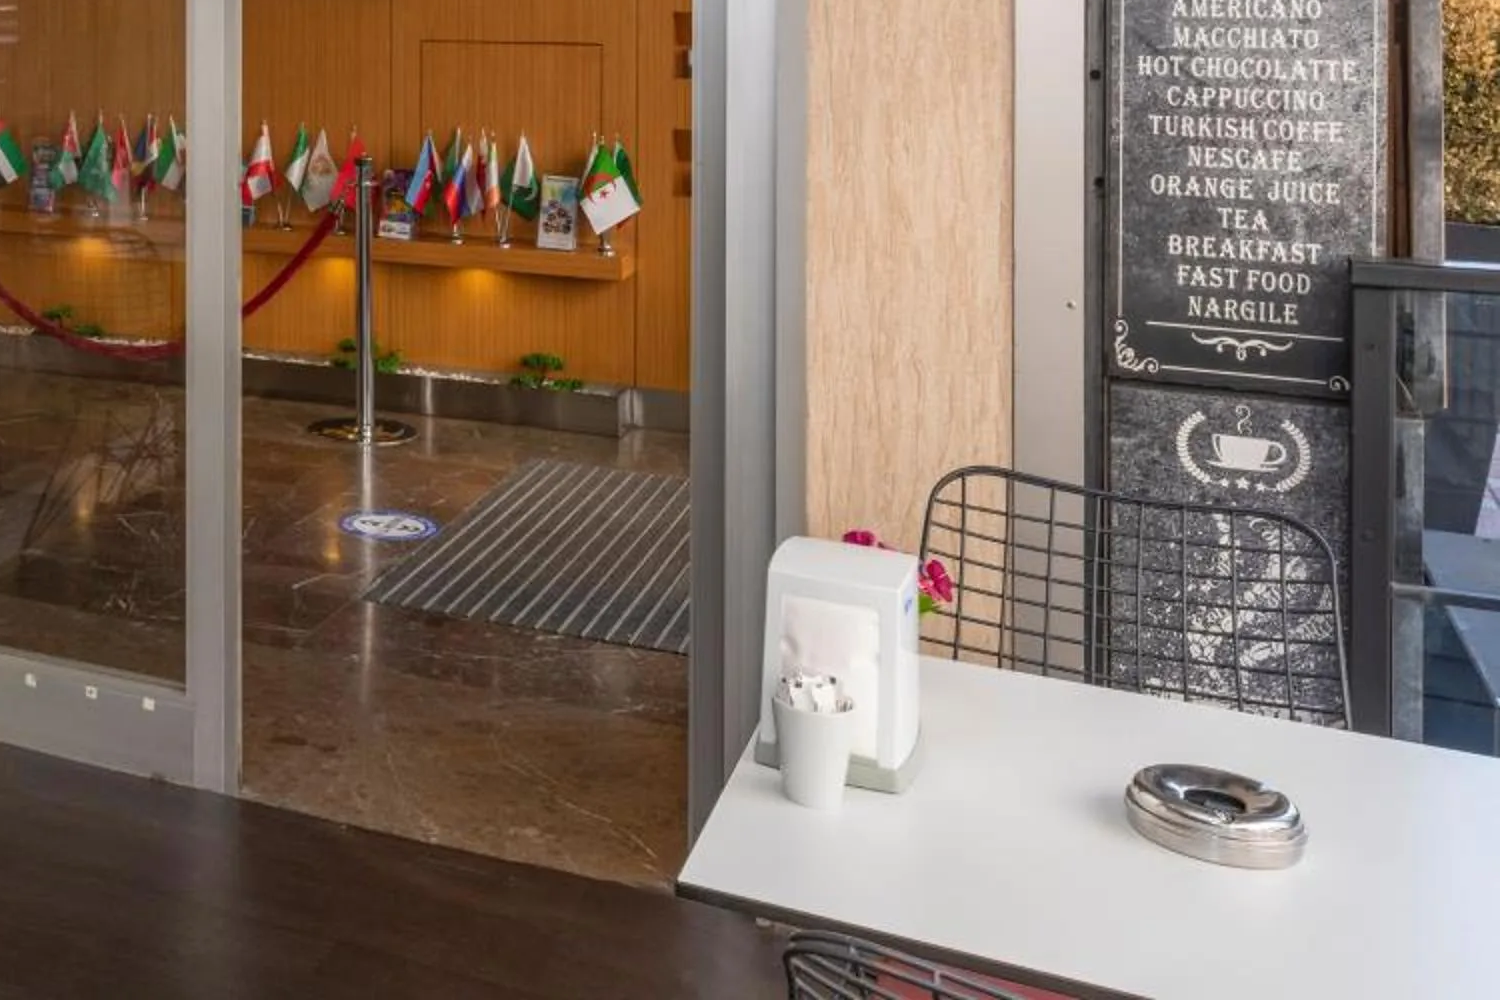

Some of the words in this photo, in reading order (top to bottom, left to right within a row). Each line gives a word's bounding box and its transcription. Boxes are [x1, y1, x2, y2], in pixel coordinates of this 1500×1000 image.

[1171, 26, 1320, 50] MACCHIATO
[1137, 55, 1185, 77] HOT
[1191, 56, 1358, 82] CHOCOLATTE
[1167, 85, 1325, 111] CAPPUCCINO
[1149, 114, 1255, 141] TURKISH
[1263, 120, 1345, 143] COFFE
[1187, 145, 1303, 172] NESCAFE
[1150, 173, 1254, 200] ORANGE
[1267, 180, 1341, 204] JUICE
[1217, 206, 1269, 232] TEA
[1167, 234, 1323, 266] BREAKFAST
[1176, 265, 1239, 290] FAST
[1246, 269, 1312, 295] FOOD
[1187, 295, 1299, 325] NARGILE
